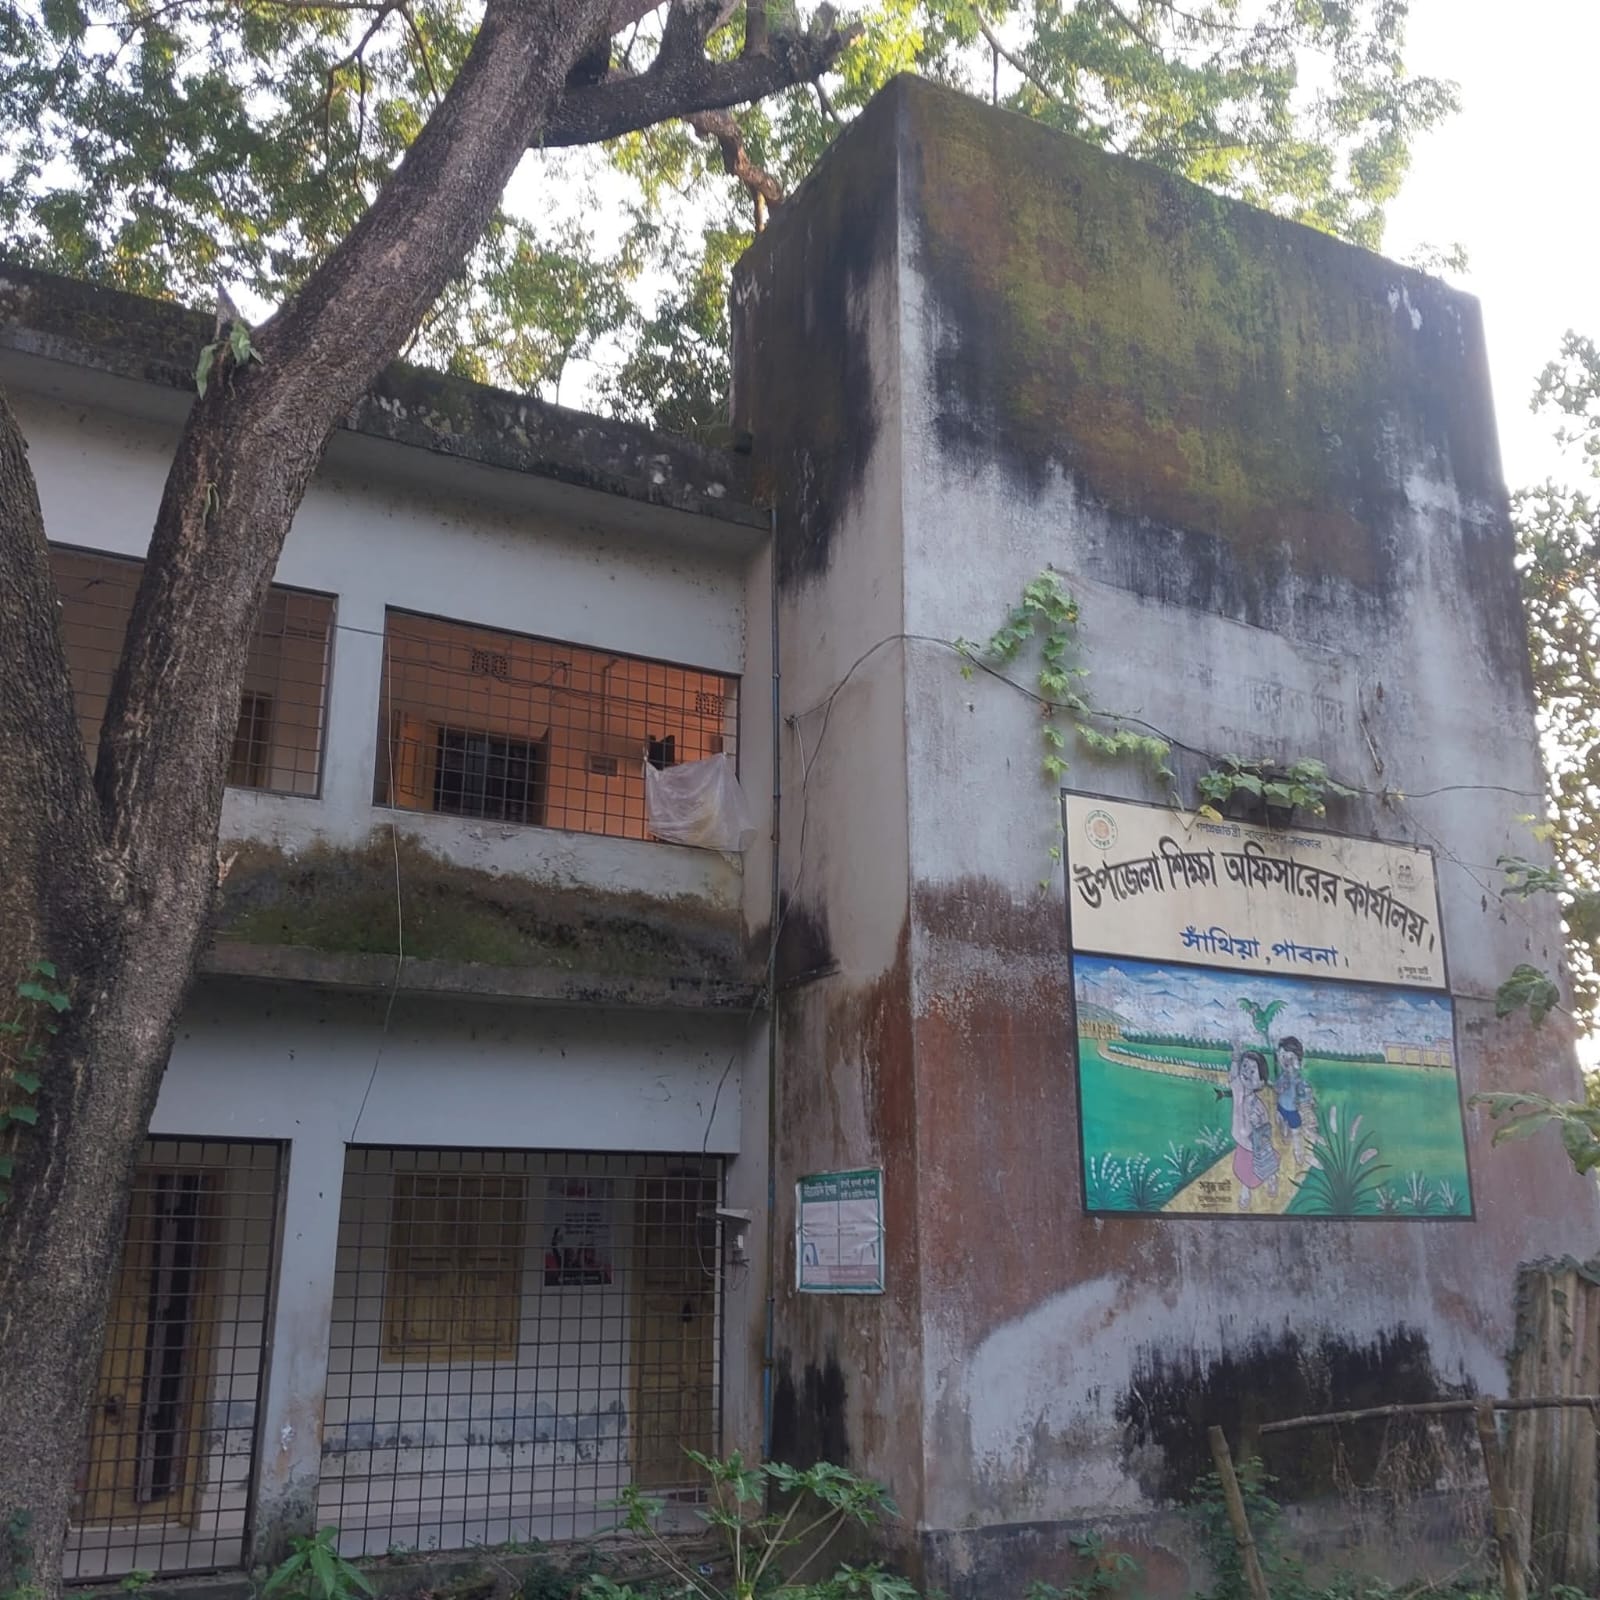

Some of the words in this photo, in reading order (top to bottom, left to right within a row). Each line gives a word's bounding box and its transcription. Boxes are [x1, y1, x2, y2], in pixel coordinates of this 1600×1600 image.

[1073, 850, 1165, 908] উপজেলা
[1159, 836, 1218, 890] শিক্ষা
[1221, 841, 1341, 906] অফিসারের
